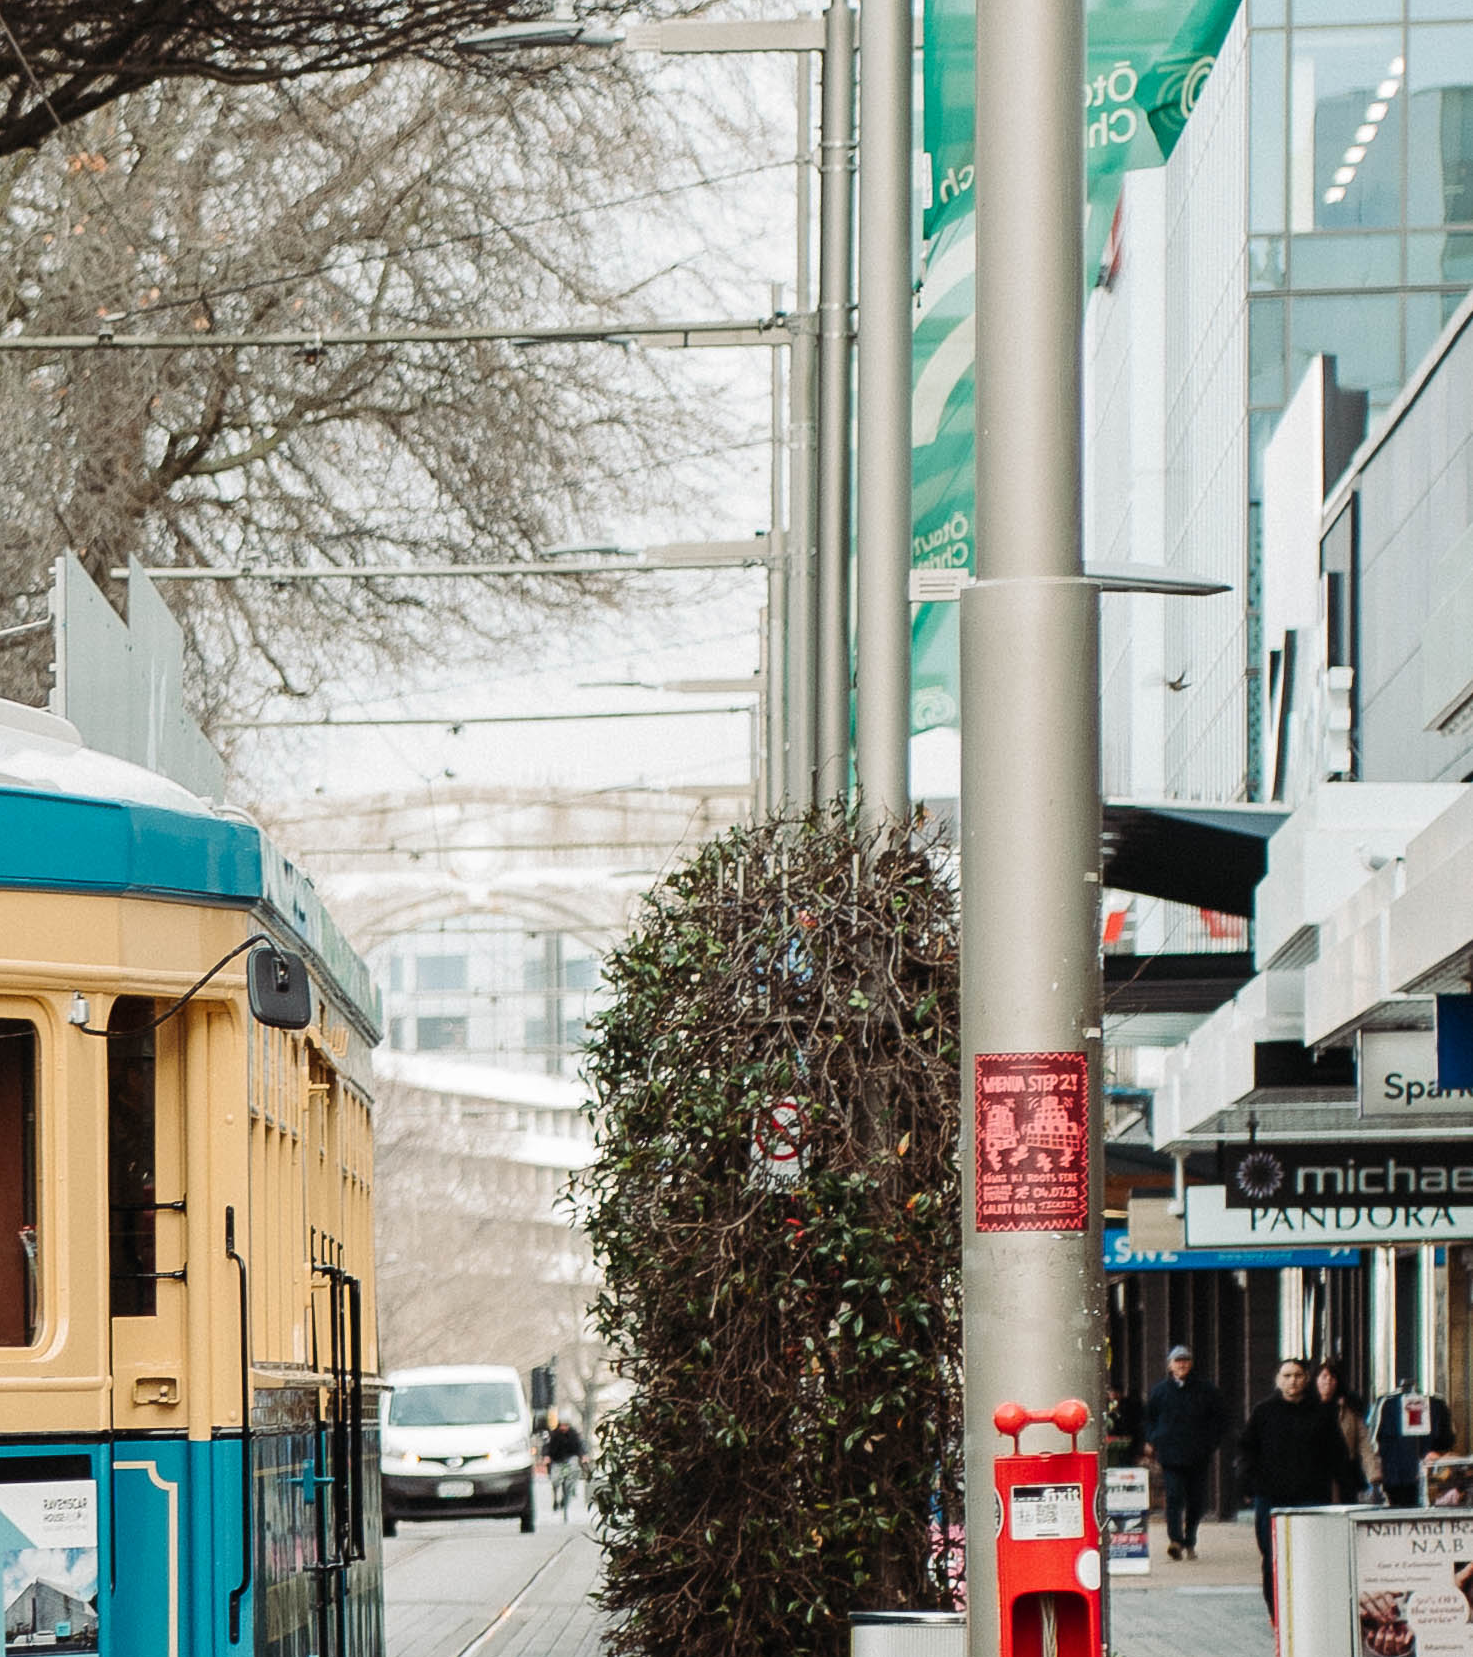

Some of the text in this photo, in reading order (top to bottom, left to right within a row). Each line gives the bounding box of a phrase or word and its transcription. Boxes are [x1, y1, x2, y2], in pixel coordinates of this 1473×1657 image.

[1249, 1206, 1457, 1232] PANDORA
[1042, 1488, 1080, 1503] fixit
[1367, 1522, 1402, 1537] Nail
[1409, 1521, 1444, 1536] And
